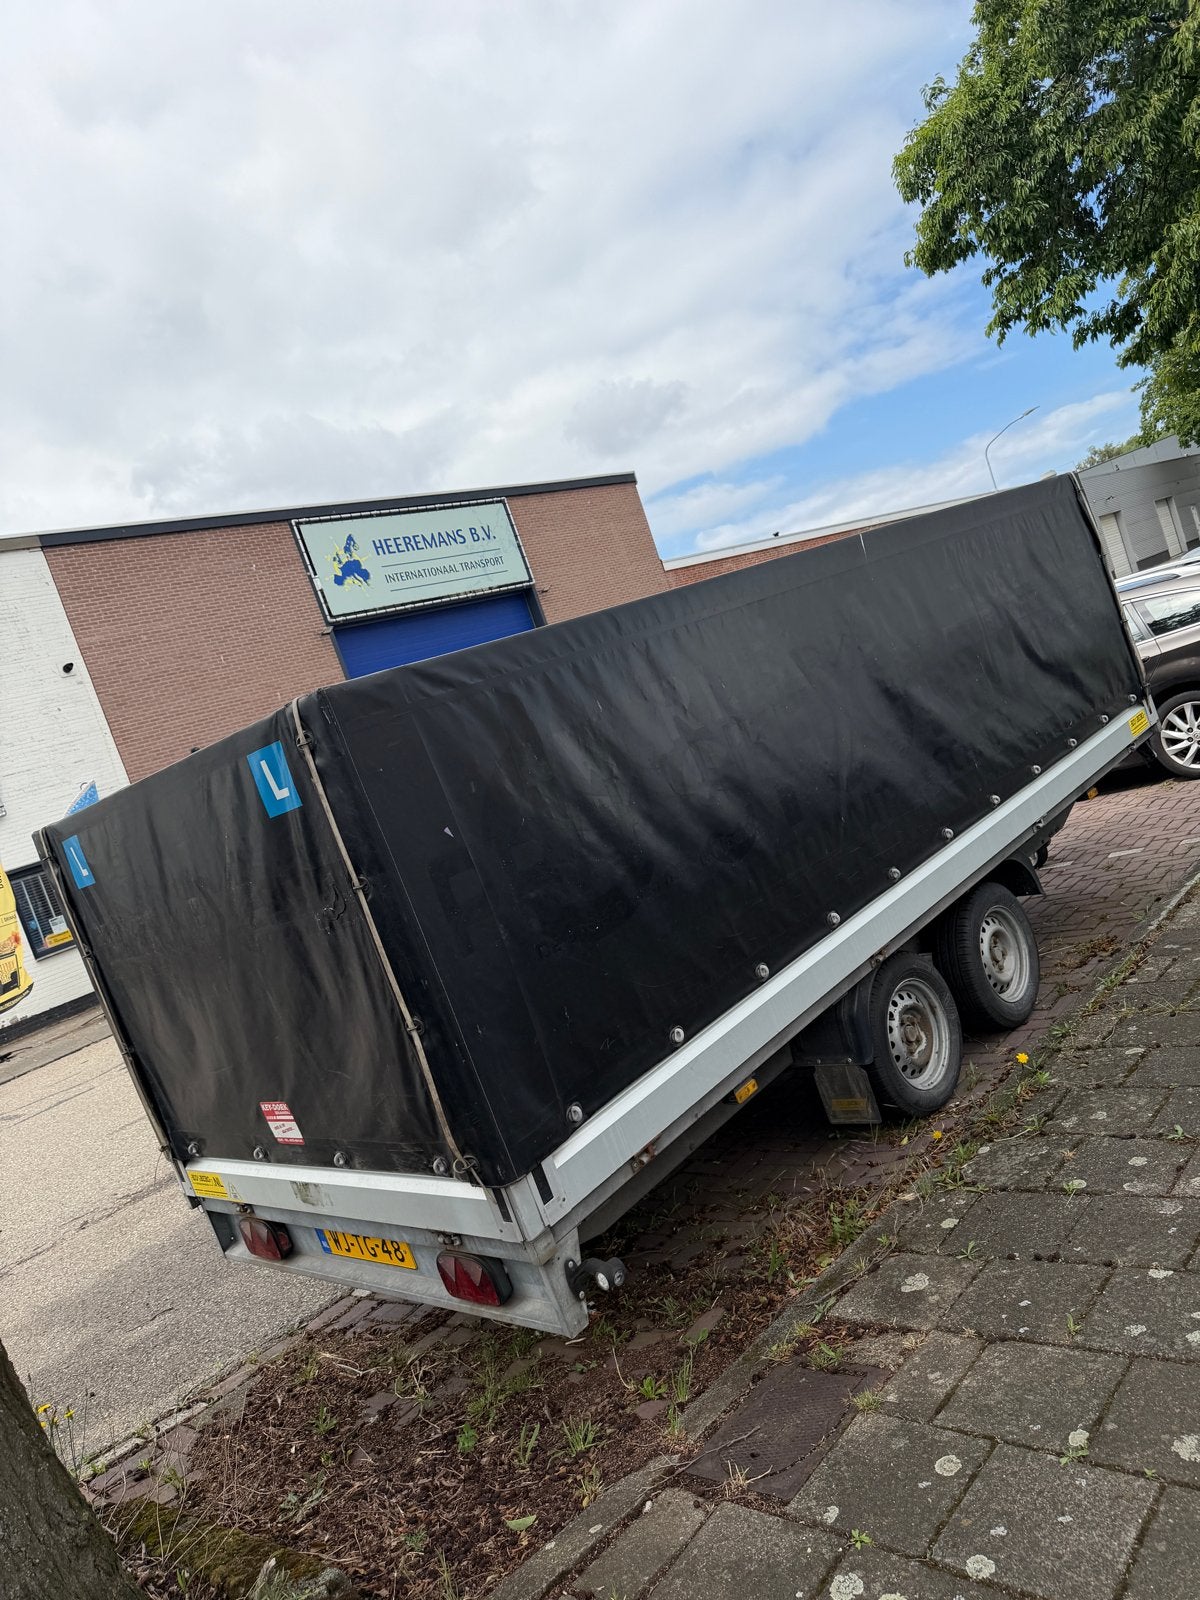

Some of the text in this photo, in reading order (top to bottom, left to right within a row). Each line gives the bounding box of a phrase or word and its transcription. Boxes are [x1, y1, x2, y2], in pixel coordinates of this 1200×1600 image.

[372, 525, 497, 556] HEEREMANS B.V.
[384, 556, 505, 584] INTERNATIONAAL TRANSPORT
[260, 760, 290, 800] L
[328, 1229, 405, 1263] WJ-TG-48
